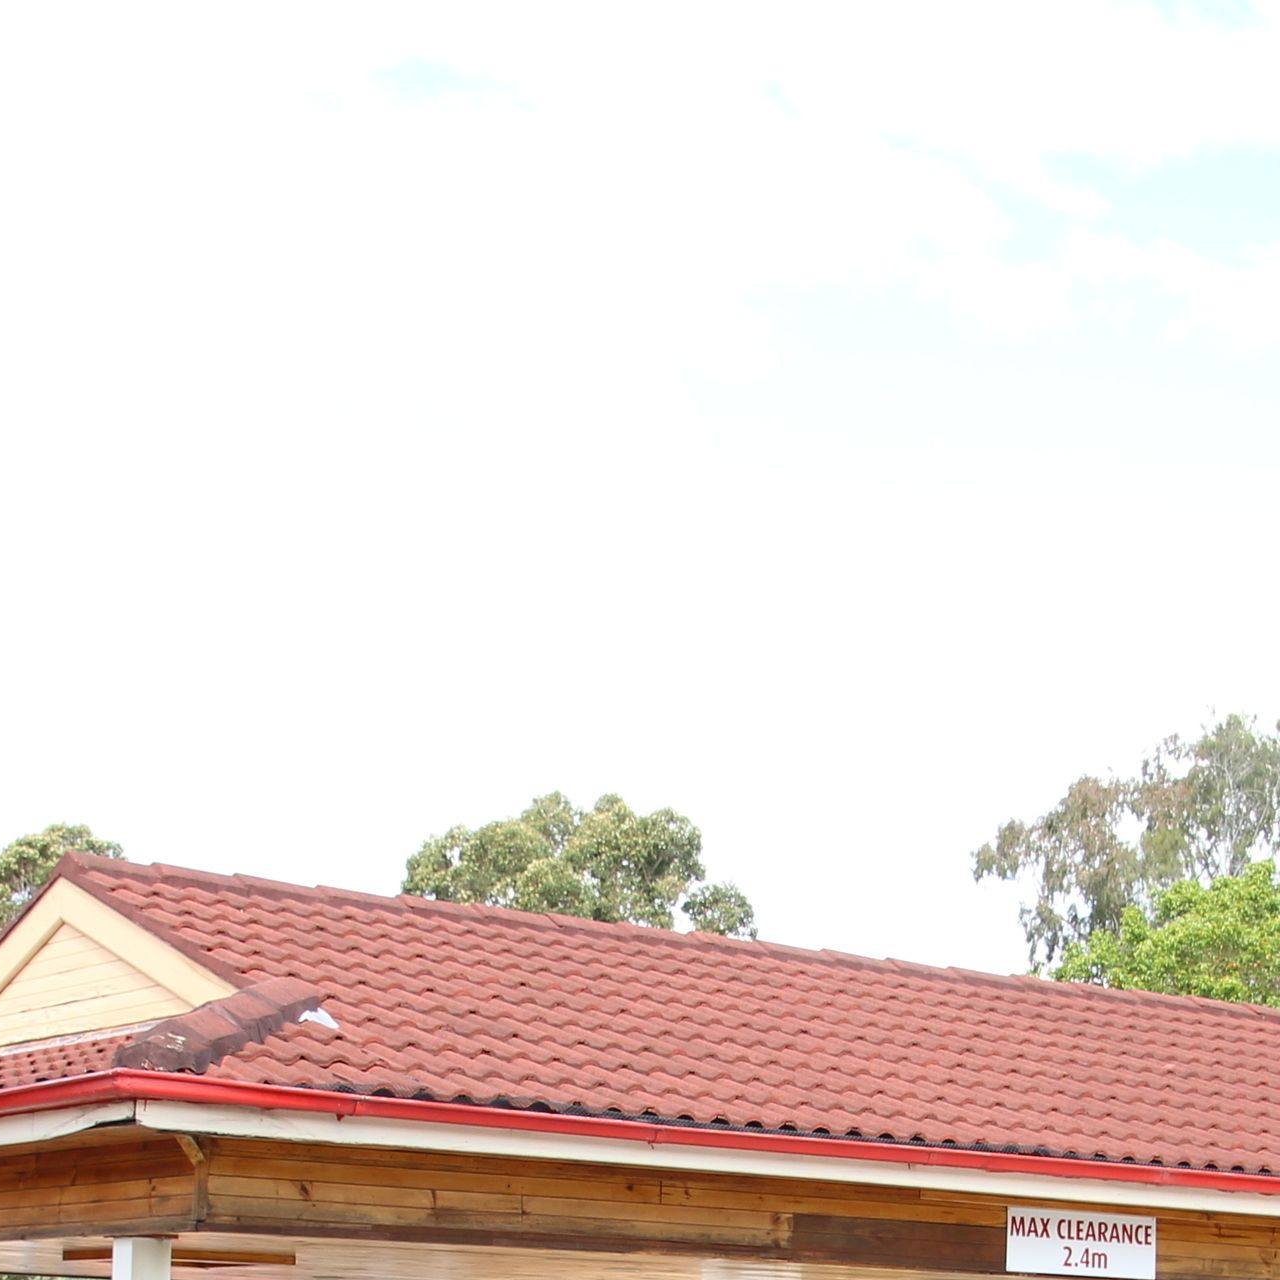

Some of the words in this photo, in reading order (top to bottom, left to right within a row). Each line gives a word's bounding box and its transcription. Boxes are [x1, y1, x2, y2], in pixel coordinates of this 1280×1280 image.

[1010, 1216, 1050, 1238] MAX
[1057, 1218, 1152, 1245] CLEARANCE
[1063, 1246, 1108, 1269] 2.4m
